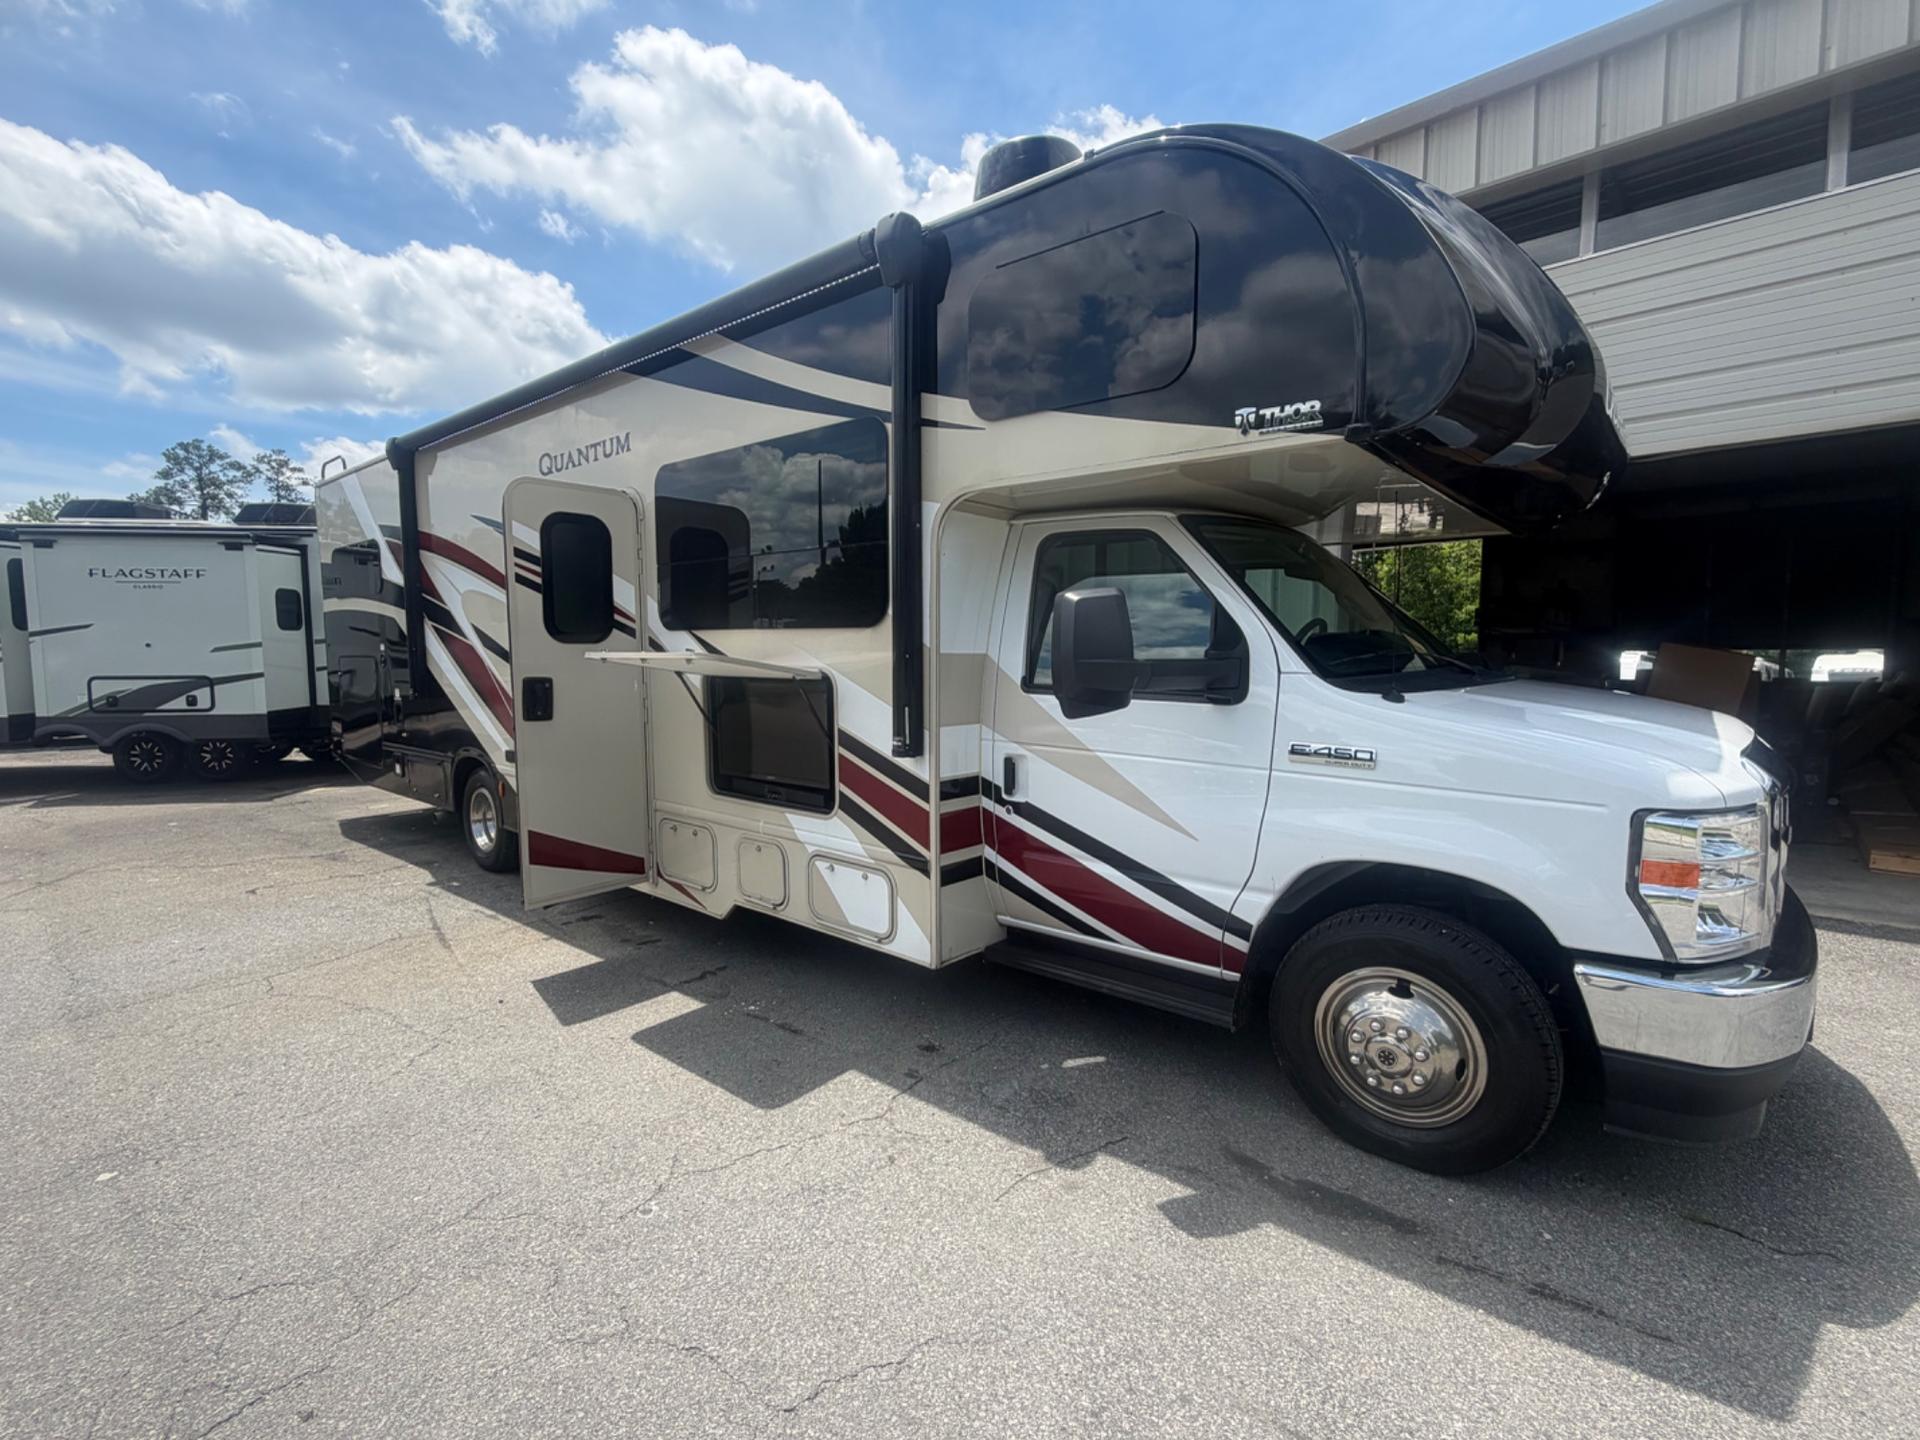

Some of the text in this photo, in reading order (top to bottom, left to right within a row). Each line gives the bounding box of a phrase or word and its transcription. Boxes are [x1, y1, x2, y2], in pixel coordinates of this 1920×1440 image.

[1259, 400, 1323, 427] THOR
[538, 432, 632, 476] QUANTUM
[88, 568, 207, 579] FLAGSTAFF
